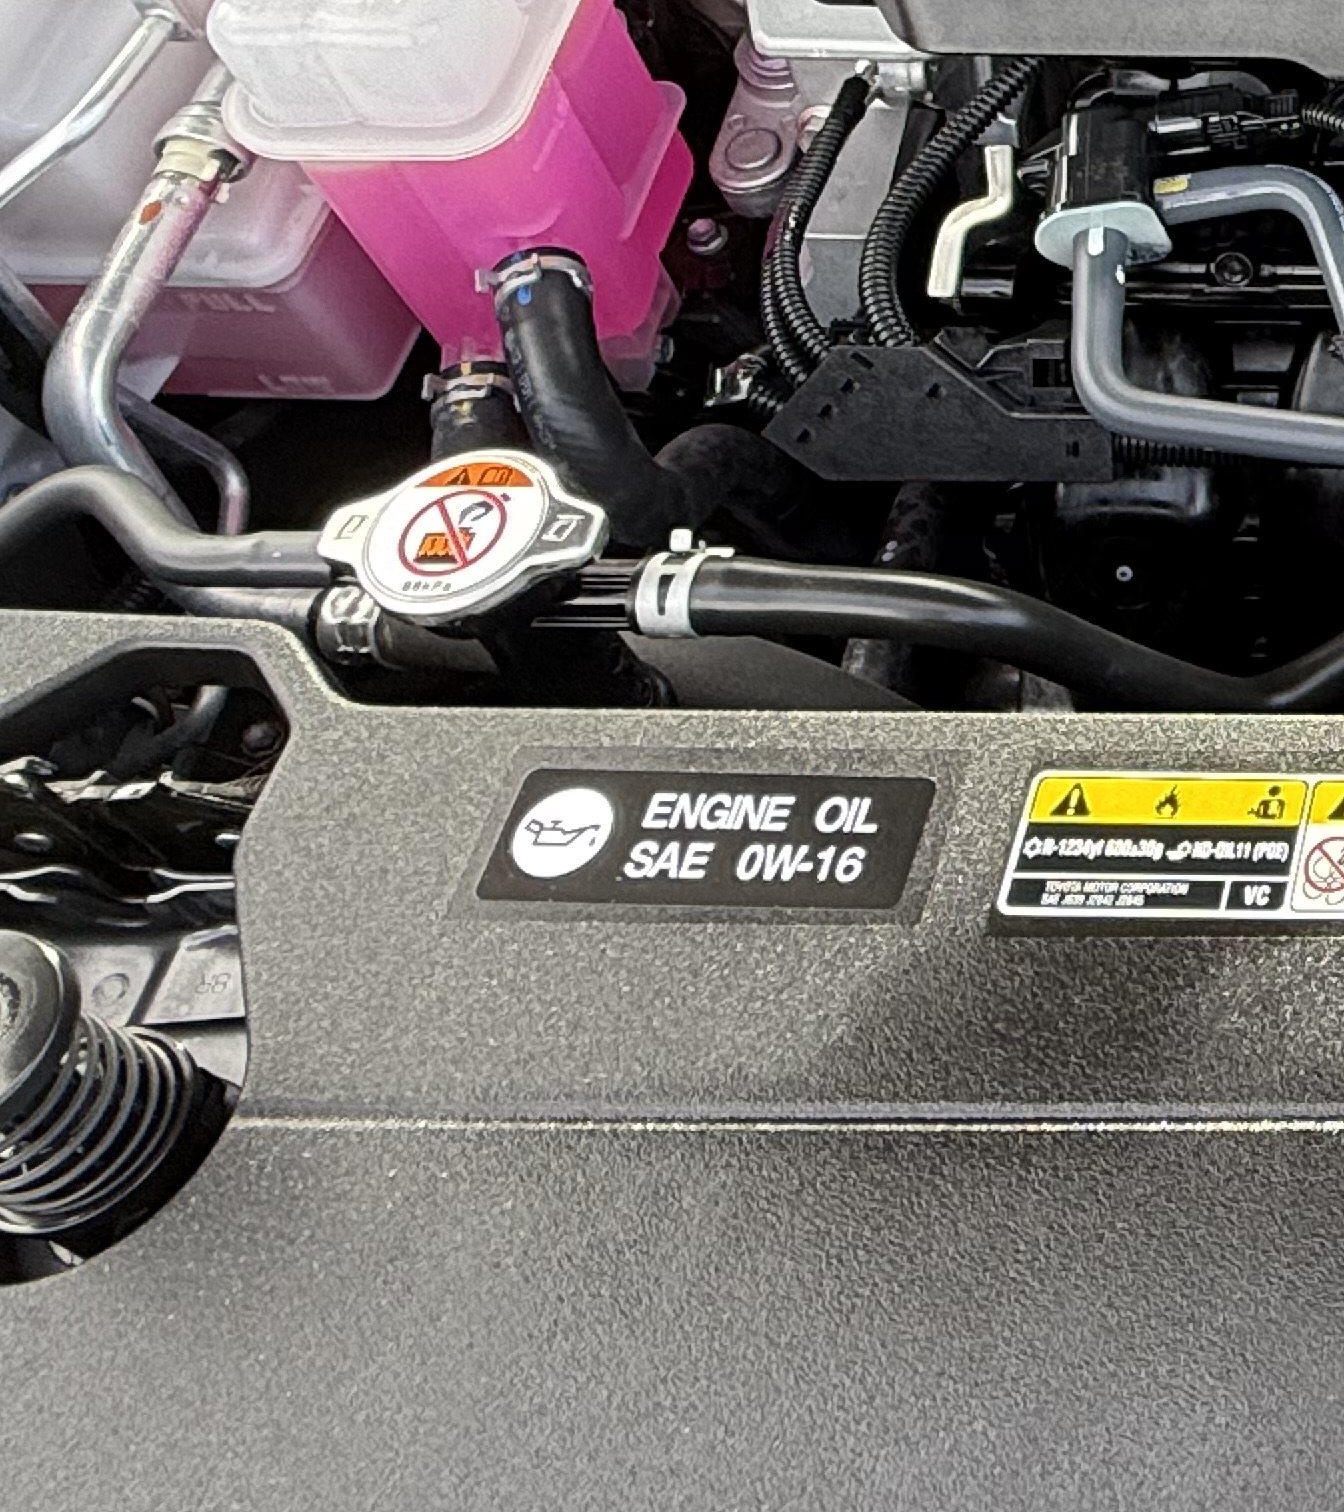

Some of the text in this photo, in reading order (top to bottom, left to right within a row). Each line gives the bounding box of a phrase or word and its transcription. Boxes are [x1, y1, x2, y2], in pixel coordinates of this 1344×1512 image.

[180, 292, 277, 313] FULL
[641, 792, 880, 835] ENGINE OIL
[622, 839, 866, 884] SAE 0W-16
[1044, 880, 1082, 893] TOYOTA
[1244, 885, 1271, 906] VC
